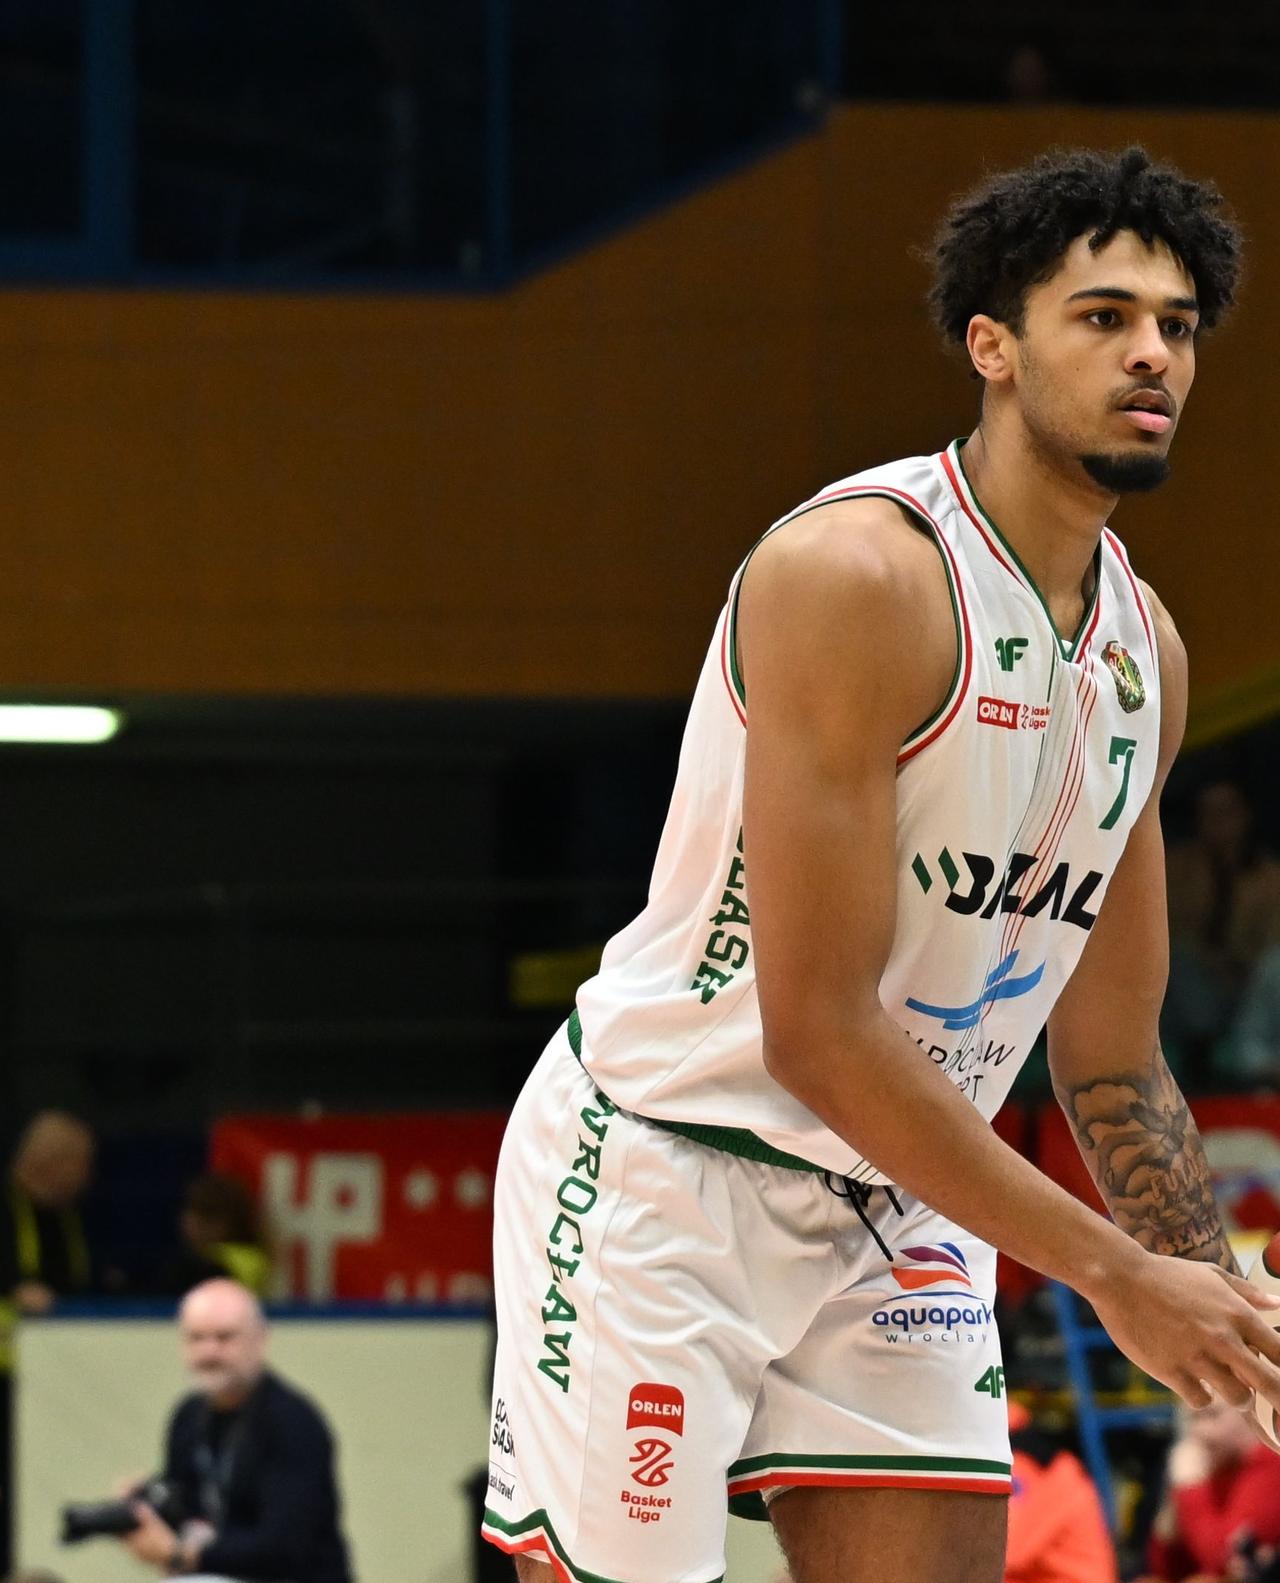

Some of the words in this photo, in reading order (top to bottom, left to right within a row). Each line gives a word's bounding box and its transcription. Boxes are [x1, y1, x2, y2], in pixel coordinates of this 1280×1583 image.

[1098, 736, 1138, 831] 7
[872, 1303, 992, 1331] aquapark
[631, 1399, 682, 1417] ORLEN
[620, 1490, 673, 1509] Basket
[628, 1506, 661, 1524] Liga
